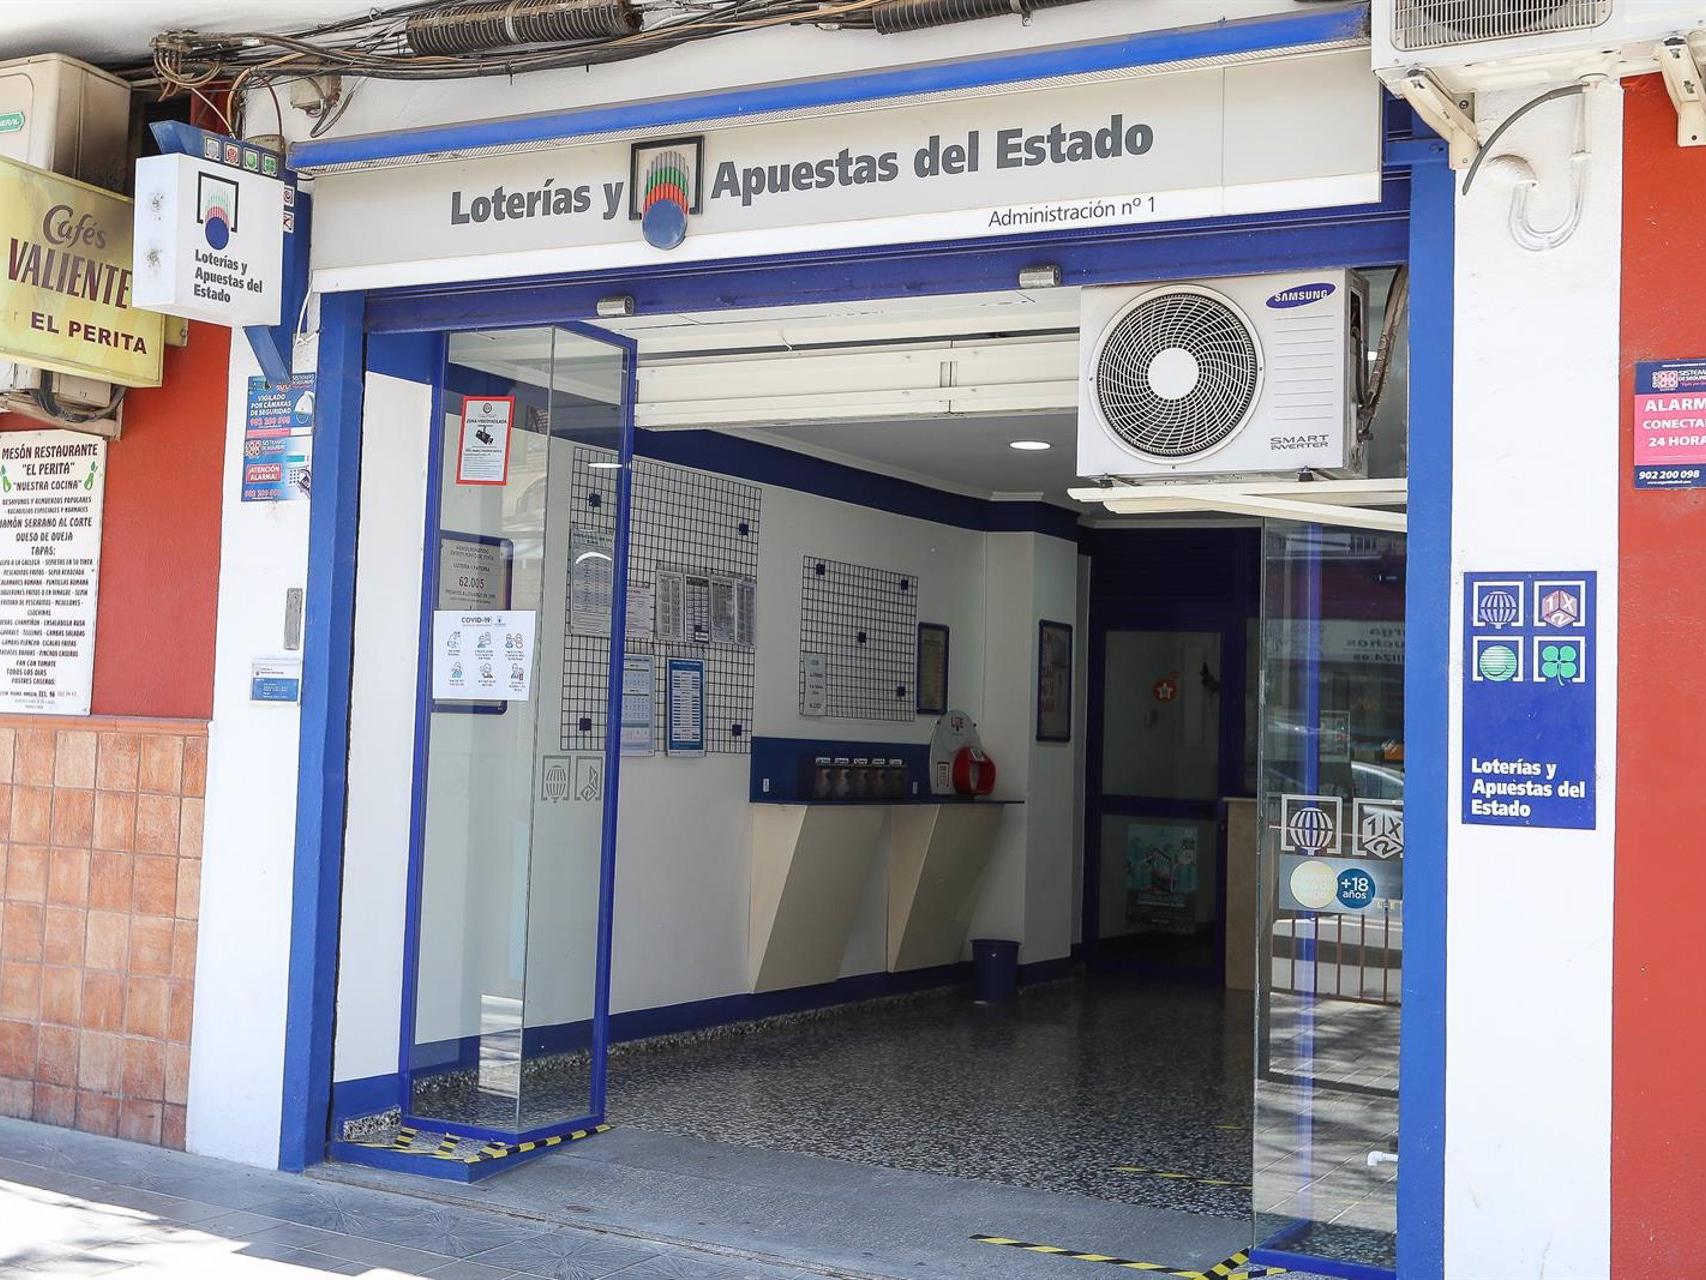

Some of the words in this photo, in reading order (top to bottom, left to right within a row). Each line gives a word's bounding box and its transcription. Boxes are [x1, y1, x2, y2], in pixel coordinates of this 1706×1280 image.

[450, 178, 592, 226] Loterías
[603, 181, 624, 219] y
[711, 147, 898, 206] Apuestas
[914, 130, 980, 179] del
[996, 114, 1154, 169] Estado
[987, 200, 1117, 228] Administración
[1148, 197, 1156, 213] 1
[43, 204, 106, 249] Cafés
[195, 249, 239, 272] Loterías
[241, 260, 248, 275] y
[8, 238, 132, 309] VALIENTE
[195, 266, 245, 291] Apuestas
[247, 277, 264, 294] del
[193, 284, 232, 304] Estado
[1274, 288, 1328, 303] SAMSUNG
[31, 312, 59, 334] EL
[69, 321, 148, 355] PERITA
[1645, 397, 1706, 412] ALARM
[1643, 418, 1706, 430] CONECTA
[1270, 434, 1329, 445] SMART
[1271, 441, 1328, 450] INVERTER
[1648, 437, 1665, 447] 24
[2, 443, 32, 460] MESÓN
[34, 443, 98, 459] RESTAURANTE
[1639, 471, 1658, 480] 902
[1659, 470, 1679, 479] 200
[1680, 470, 1700, 479] 098
[24, 518, 57, 529] SERRANO
[69, 517, 92, 527] CORTE
[1471, 758, 1542, 776] Loterías
[1546, 764, 1557, 780] y
[1471, 779, 1553, 799] Apuestas
[1557, 781, 1586, 798] del
[1471, 799, 1531, 818] Estado
[1341, 877, 1369, 892] +18
[1342, 890, 1367, 900] años
